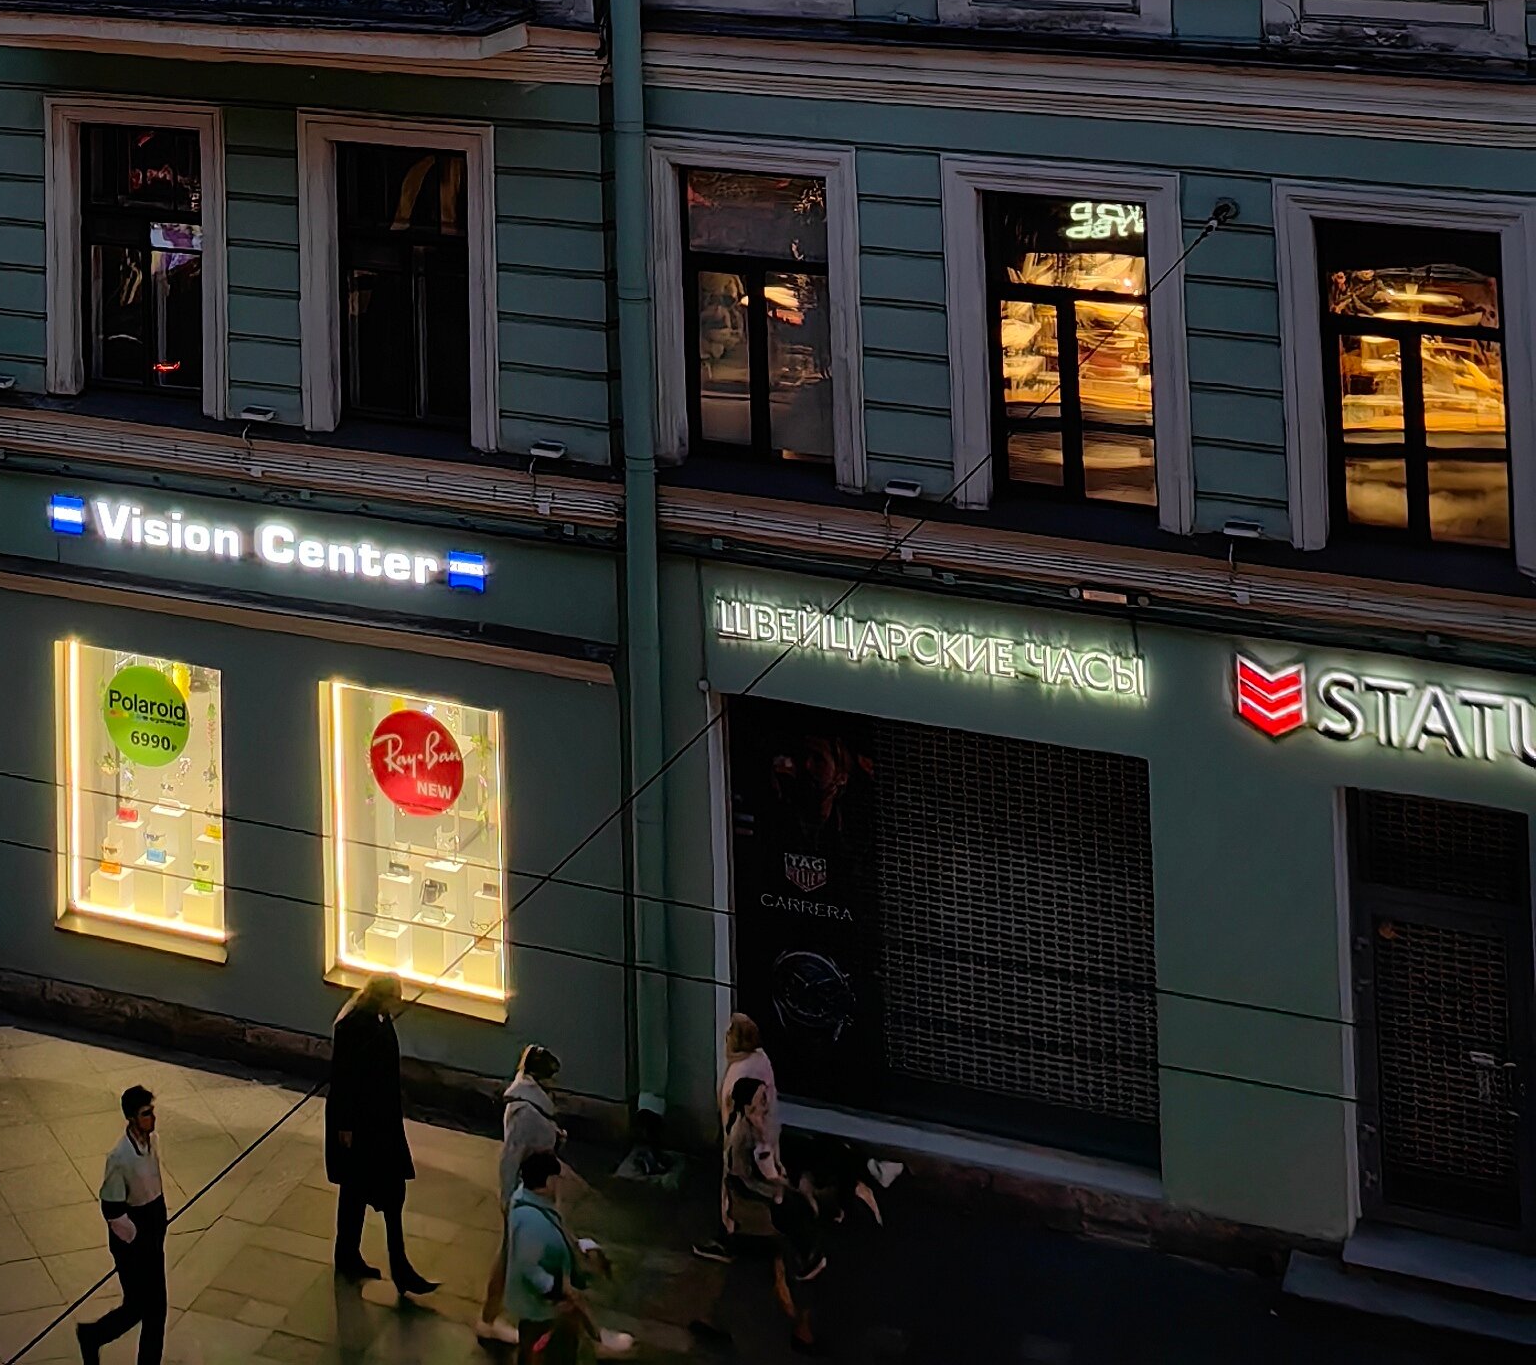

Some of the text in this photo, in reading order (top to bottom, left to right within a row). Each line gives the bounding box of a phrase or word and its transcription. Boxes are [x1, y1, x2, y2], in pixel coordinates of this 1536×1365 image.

[96, 500, 438, 584] Vision Center
[716, 596, 1147, 697] ШВЕЙЦАРСКИЕ ЧАСЫ
[109, 689, 186, 721] Polaroid
[417, 781, 452, 800] NEW
[788, 854, 823, 872] TAG
[760, 893, 854, 922] CARRERA
